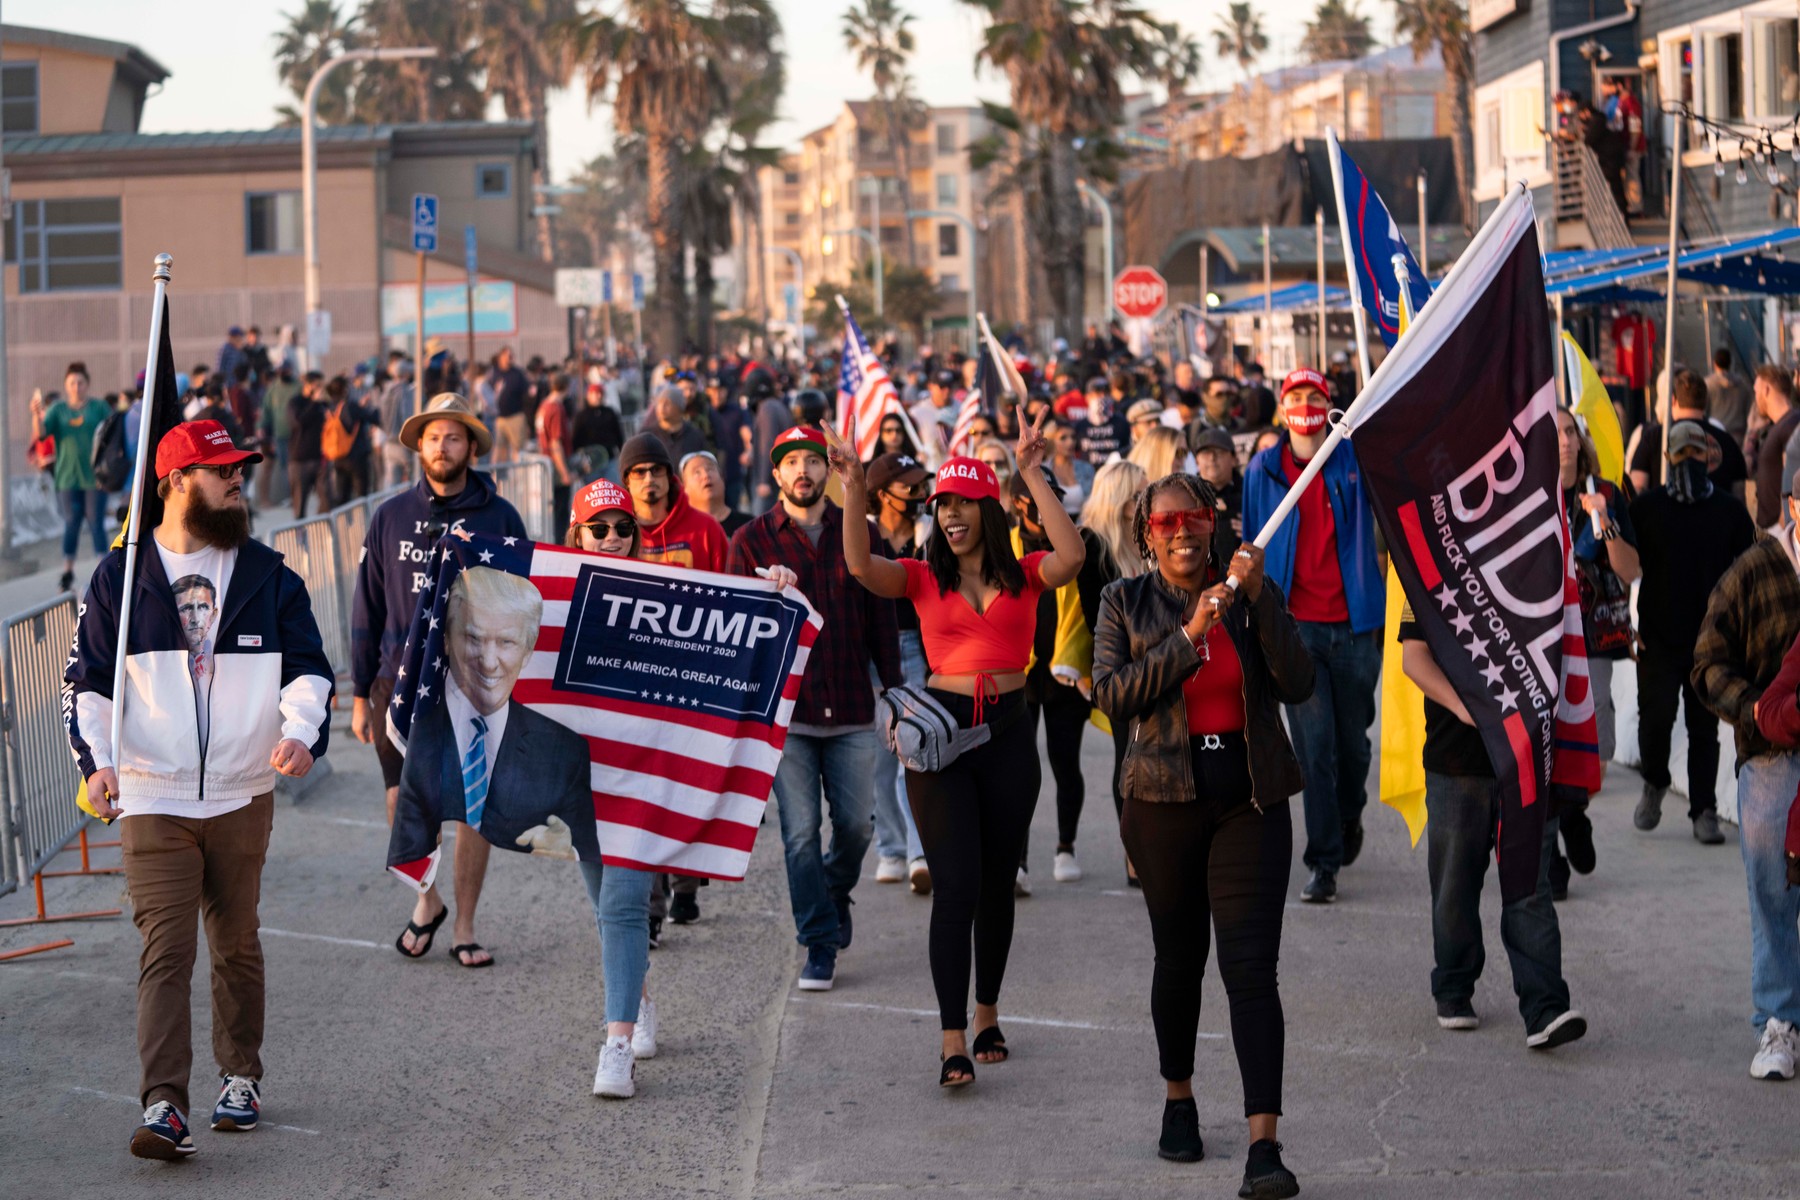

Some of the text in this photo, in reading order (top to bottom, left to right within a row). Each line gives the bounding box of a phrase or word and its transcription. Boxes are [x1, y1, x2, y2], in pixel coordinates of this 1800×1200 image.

[1117, 282, 1163, 305] STOP
[1288, 414, 1325, 426] TRUMP
[591, 480, 615, 490] KEEP
[938, 464, 979, 482] MAGA
[584, 489, 625, 502] AMERICA
[590, 497, 621, 507] GREAT
[1430, 493, 1447, 525] AND
[1438, 523, 1467, 570] FUCK
[1447, 427, 1563, 719] BID
[1460, 566, 1489, 607] YOU
[602, 593, 780, 649] TRUMP
[1482, 606, 1511, 645] FOR
[629, 633, 737, 658] FOR PRESIDENT 2020
[586, 655, 761, 692] MAKE AMERICA GREAT AGAIN!
[1505, 641, 1547, 709] VOTING
[1537, 709, 1551, 746] FOR
